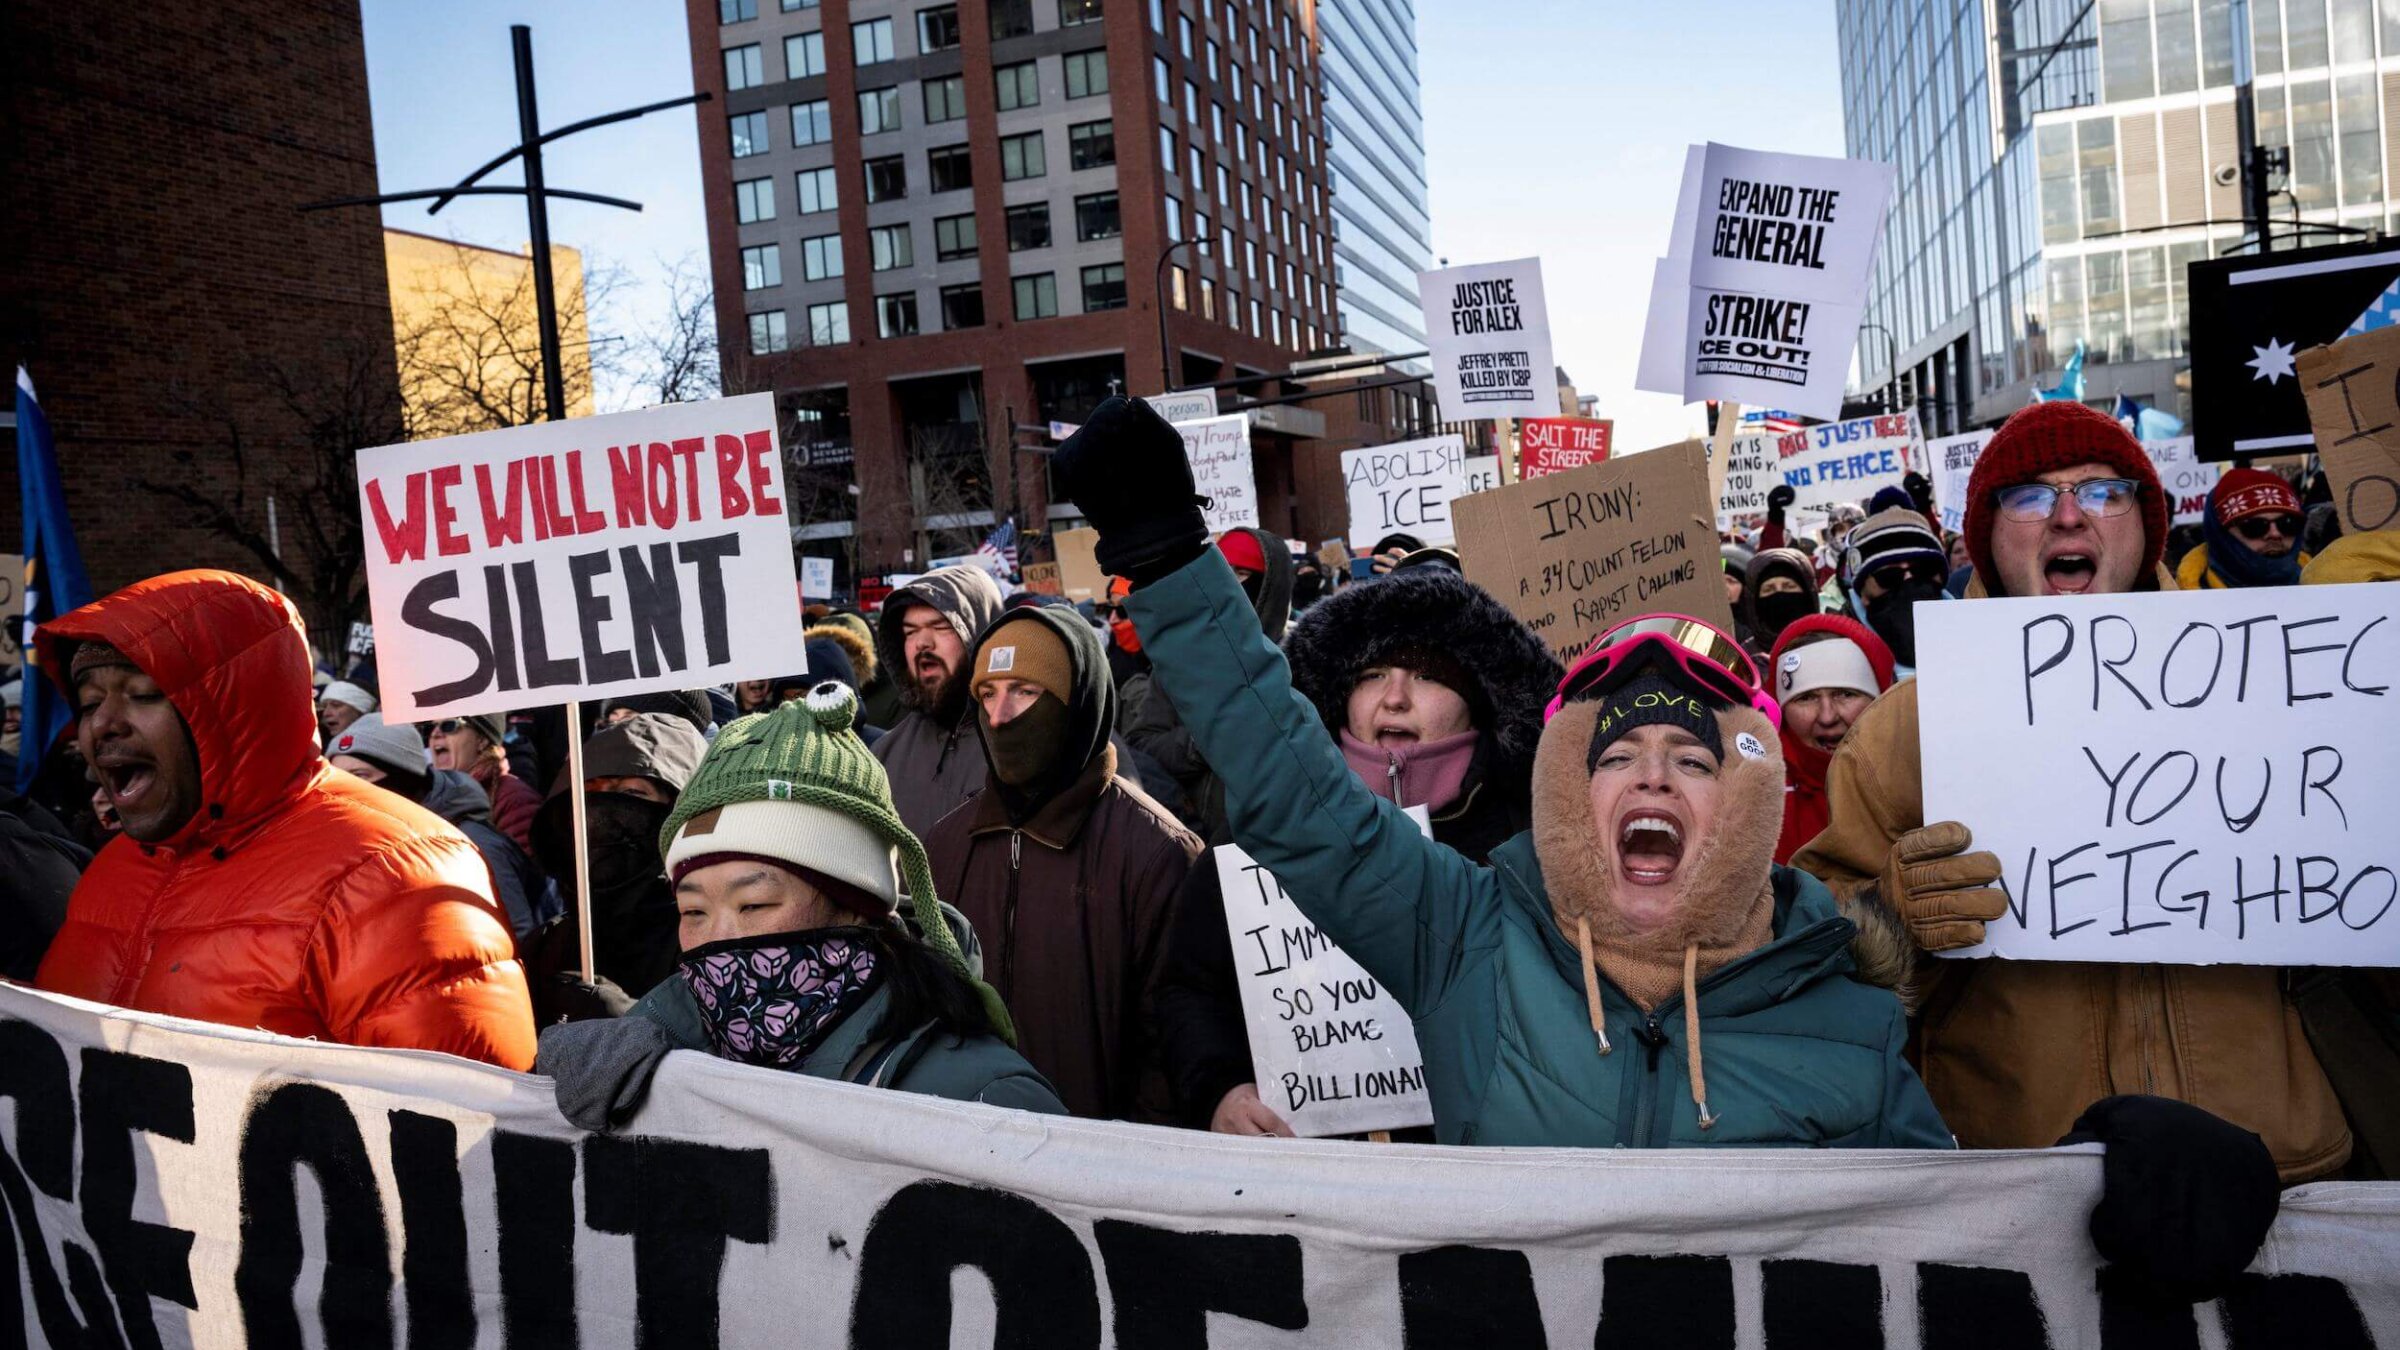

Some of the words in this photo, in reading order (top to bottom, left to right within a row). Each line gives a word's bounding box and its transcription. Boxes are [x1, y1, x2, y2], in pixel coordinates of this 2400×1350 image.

[1719, 178, 1793, 218] EXPAND
[1798, 187, 1840, 223] THE
[1712, 213, 1826, 270] GENERAL
[1452, 278, 1516, 309] JUSTICE
[1452, 309, 1484, 335] FOR
[1486, 305, 1523, 333] ALEX
[1705, 294, 1810, 345] STRIKE!
[1458, 353, 1497, 371] JEFFREY
[1499, 351, 1530, 367] PRETTI
[1736, 343, 1811, 365] OUT!
[1460, 371, 1496, 389] KILLED
[1498, 371, 1511, 387] BY
[1512, 370, 1531, 387] CBP
[1200, 425, 1243, 447] Trump
[1525, 423, 1567, 448] SALT
[1571, 426, 1604, 450] THE
[1750, 438, 1762, 453] IS
[1816, 414, 1909, 448] JUSTICE
[1945, 441, 1979, 458] JUSTICE
[1945, 458, 1961, 471] FOR
[1347, 446, 1462, 488] ABOLISH
[1727, 475, 1752, 491] YOU
[1783, 467, 1812, 487] NO
[2176, 471, 2207, 488] ON
[365, 465, 471, 564] WE
[474, 450, 607, 548] WILL
[608, 437, 705, 530] NOT
[715, 430, 782, 519] BE
[1378, 485, 1446, 530] ICE
[1533, 482, 1642, 541] IRONY:
[1519, 577, 1530, 597] A
[1568, 547, 1625, 592] COUNT
[1629, 531, 1687, 564] FELON
[1527, 612, 1556, 631] AND
[1573, 584, 1630, 629] RAPIST
[1637, 559, 1697, 601] CALLING
[400, 532, 741, 708] SILENT
[1600, 691, 1705, 733] #LOVE
[1746, 737, 1758, 748] BE
[2083, 745, 2348, 833] YOUR
[1244, 924, 1337, 977] IMM
[1273, 986, 1314, 1021] SO
[1320, 977, 1377, 1012] YOU
[1291, 1018, 1384, 1053] BLAME
